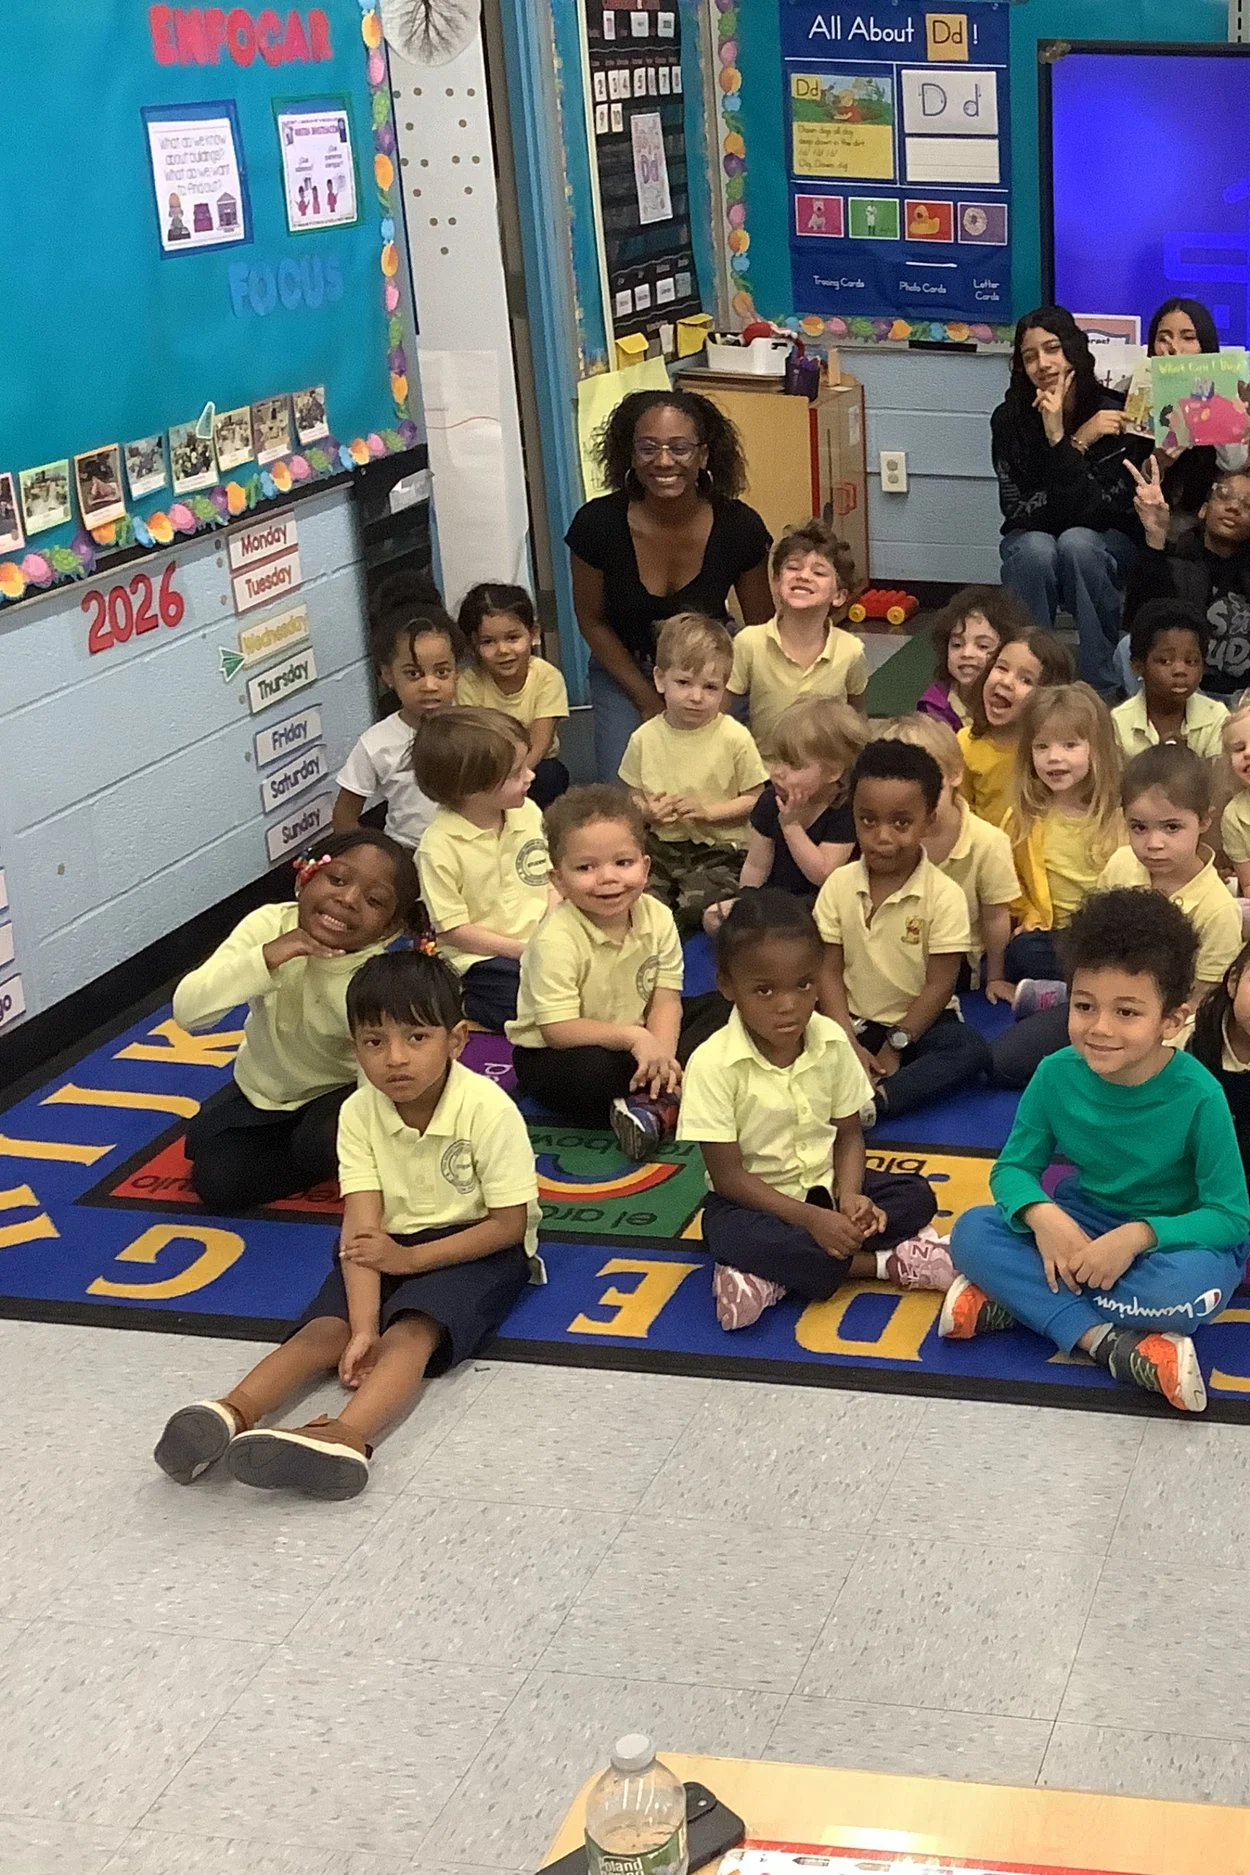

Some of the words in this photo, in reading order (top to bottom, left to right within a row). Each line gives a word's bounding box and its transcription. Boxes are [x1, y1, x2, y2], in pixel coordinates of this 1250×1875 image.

[809, 15, 841, 40] All
[848, 16, 915, 42] About
[933, 20, 963, 44] Dd
[796, 78, 819, 97] Dd
[922, 83, 947, 116] D
[963, 83, 979, 117] d
[227, 255, 345, 318] FOCUS
[840, 277, 865, 288] Cards
[922, 284, 947, 294] Cards
[973, 279, 1000, 289] Letter
[975, 291, 1000, 301] Cards
[241, 522, 289, 557] Monday
[245, 563, 293, 598] Tuesday
[81, 560, 185, 655] 2026
[241, 612, 308, 654] Wednesday
[257, 658, 310, 702] Thursday
[271, 718, 309, 751] Friday
[270, 754, 321, 800] Saturday
[281, 808, 322, 845] Sunday
[610, 1211, 659, 1229] el
[85, 1224, 246, 1300] G
[567, 1257, 704, 1339] E
[1093, 1288, 1223, 1319] Champion
[795, 1281, 947, 1362] D
